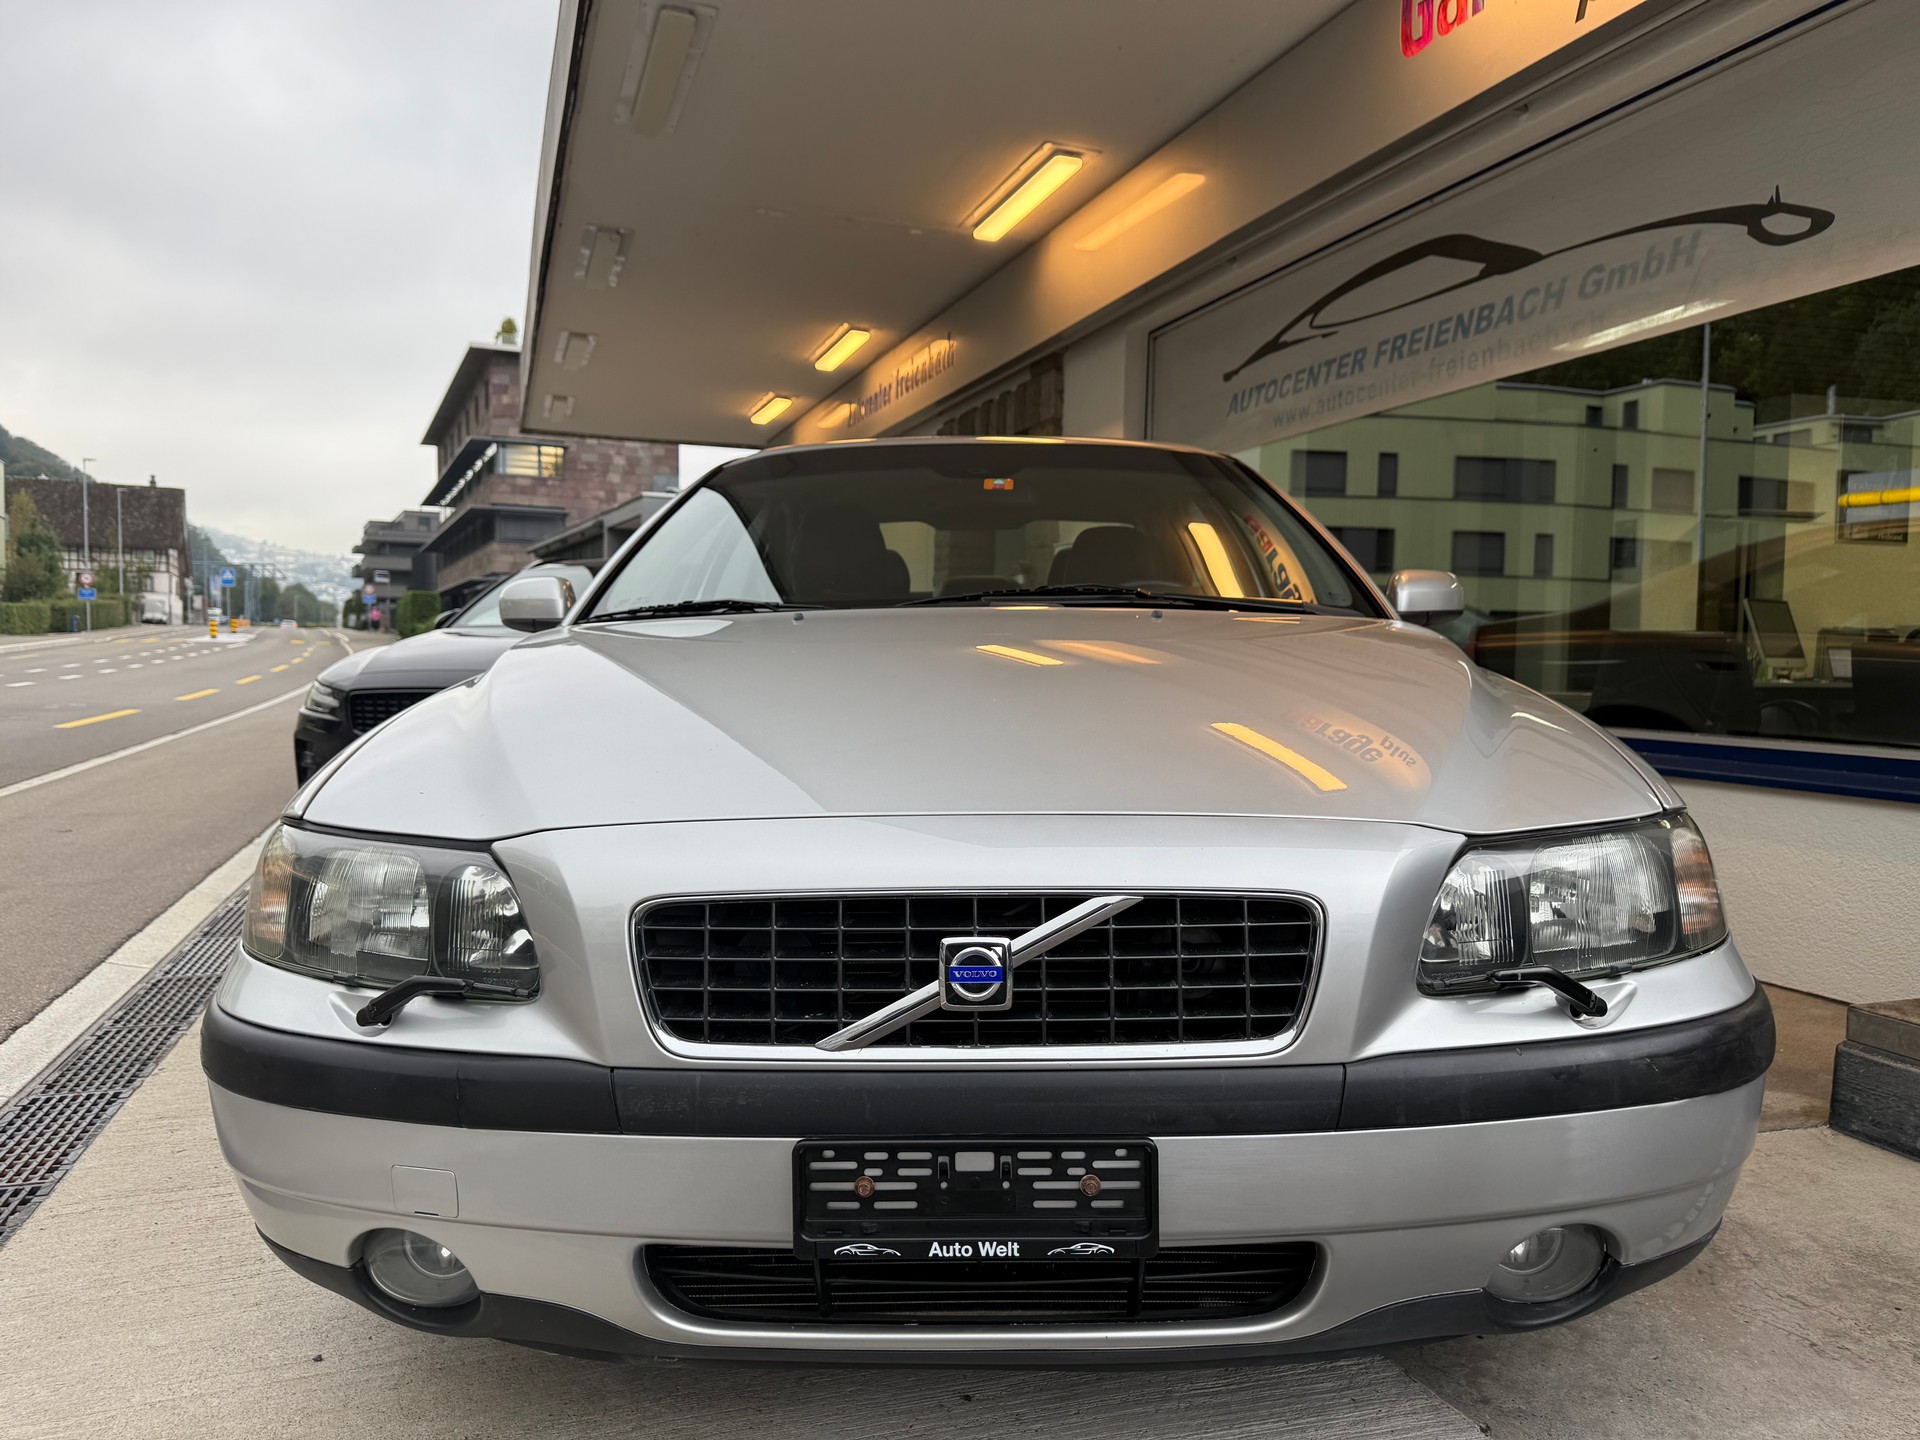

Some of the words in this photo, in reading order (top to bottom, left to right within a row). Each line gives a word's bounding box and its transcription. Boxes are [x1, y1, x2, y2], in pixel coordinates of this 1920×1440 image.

[1226, 348, 1369, 417] AUTOCENTER
[1374, 276, 1569, 369] FREIENBACH
[1577, 228, 1703, 300] GmbH
[953, 970, 998, 978] VOLVO
[928, 1241, 973, 1258] Auto
[978, 1241, 1020, 1258] Welt
